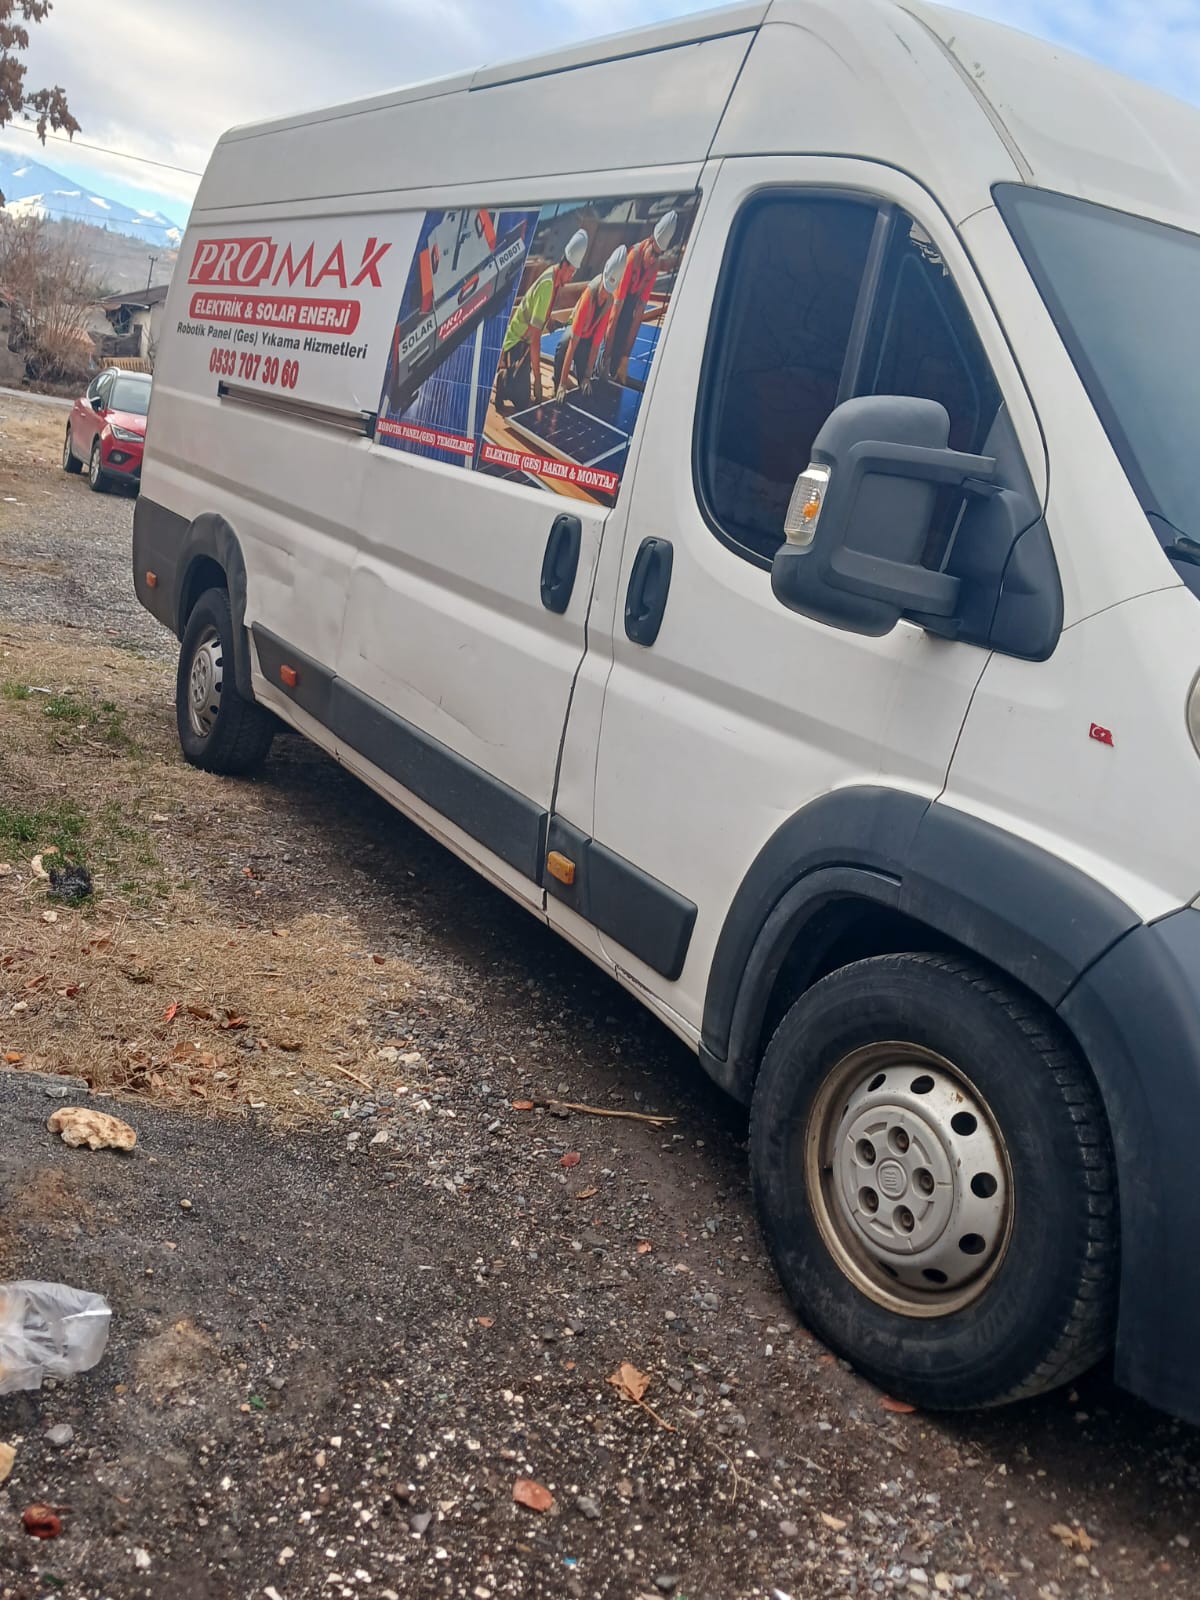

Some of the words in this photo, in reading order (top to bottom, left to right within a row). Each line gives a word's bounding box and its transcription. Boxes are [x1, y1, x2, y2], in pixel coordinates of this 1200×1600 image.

[188, 237, 393, 289] PROMAK
[499, 242, 521, 267] ROBOT
[194, 296, 243, 319] ELEKTRİK
[244, 302, 254, 320] &
[256, 302, 297, 323] SOLAR
[177, 321, 206, 337] Robotik
[207, 325, 232, 341] Panel
[233, 327, 259, 347] (Ges)
[262, 331, 300, 350] Yıkama
[303, 336, 369, 360] Hizmetleri
[402, 319, 434, 355] SOLAR
[209, 347, 237, 377] 0533
[238, 351, 262, 381] 707
[262, 356, 280, 385] 30
[281, 358, 299, 390] 60
[521, 455, 543, 475] (GES)
[542, 460, 568, 479] BAKIM
[568, 467, 577, 480] &
[577, 469, 617, 490] MONTAJ
